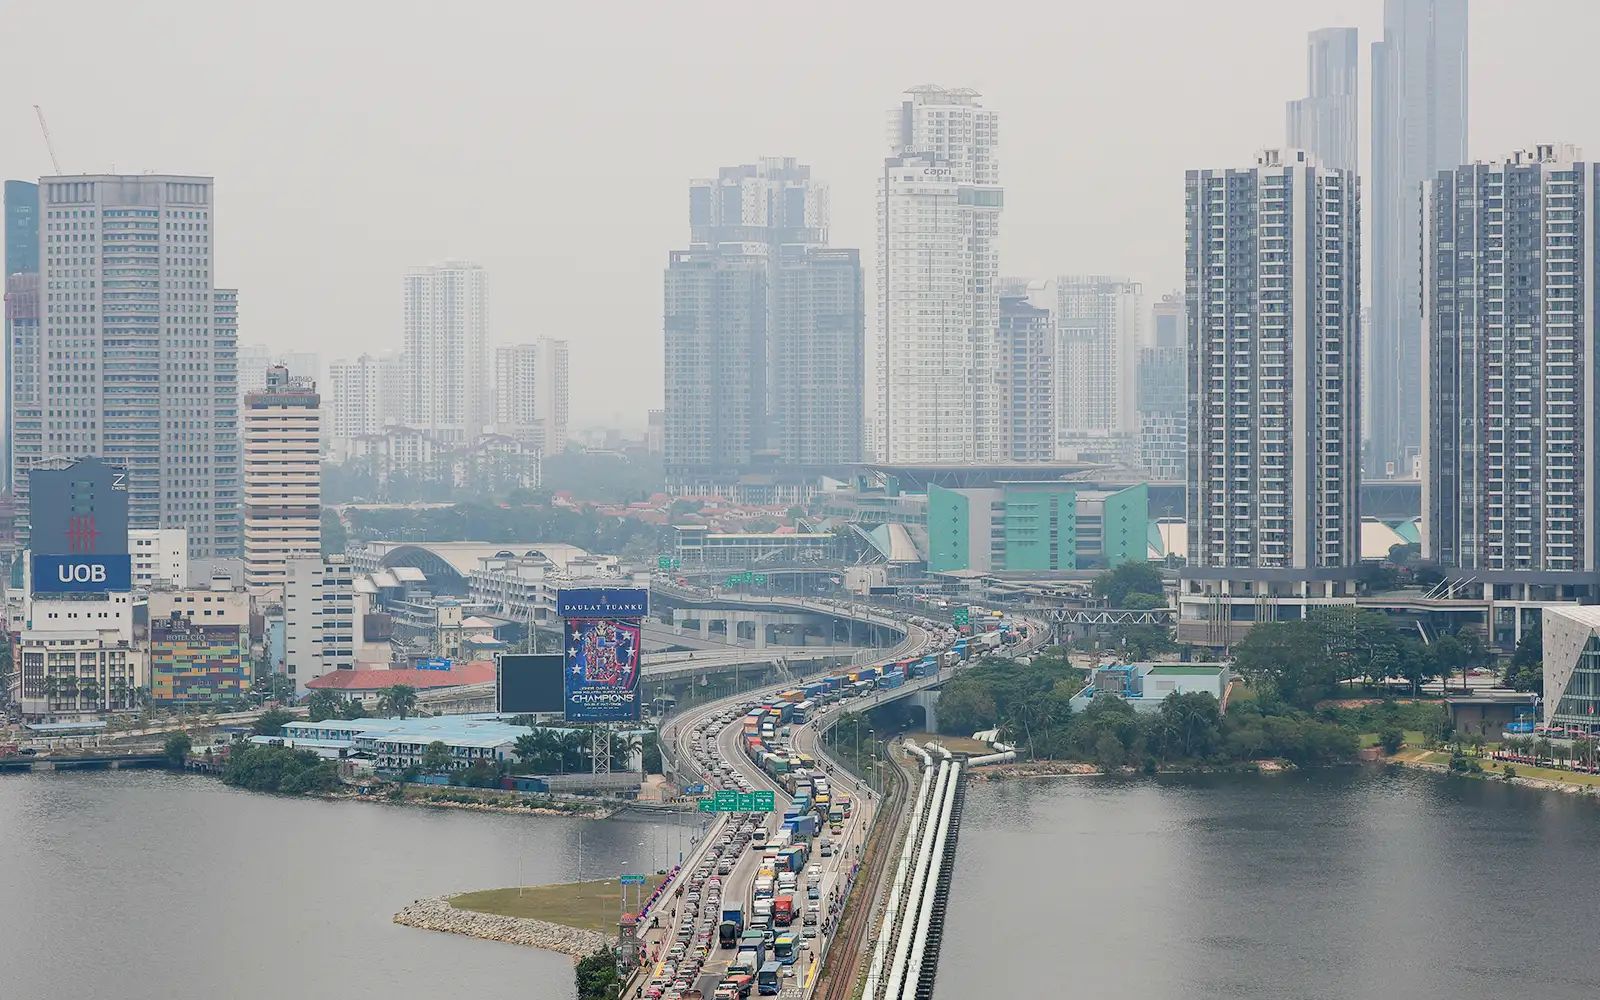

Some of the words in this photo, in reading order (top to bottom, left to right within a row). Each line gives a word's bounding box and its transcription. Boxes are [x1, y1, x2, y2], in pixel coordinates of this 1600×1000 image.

[923, 168, 951, 177] capri
[112, 473, 126, 486] Z
[58, 563, 107, 583] UOB
[571, 694, 634, 703] CHAMPIONS
